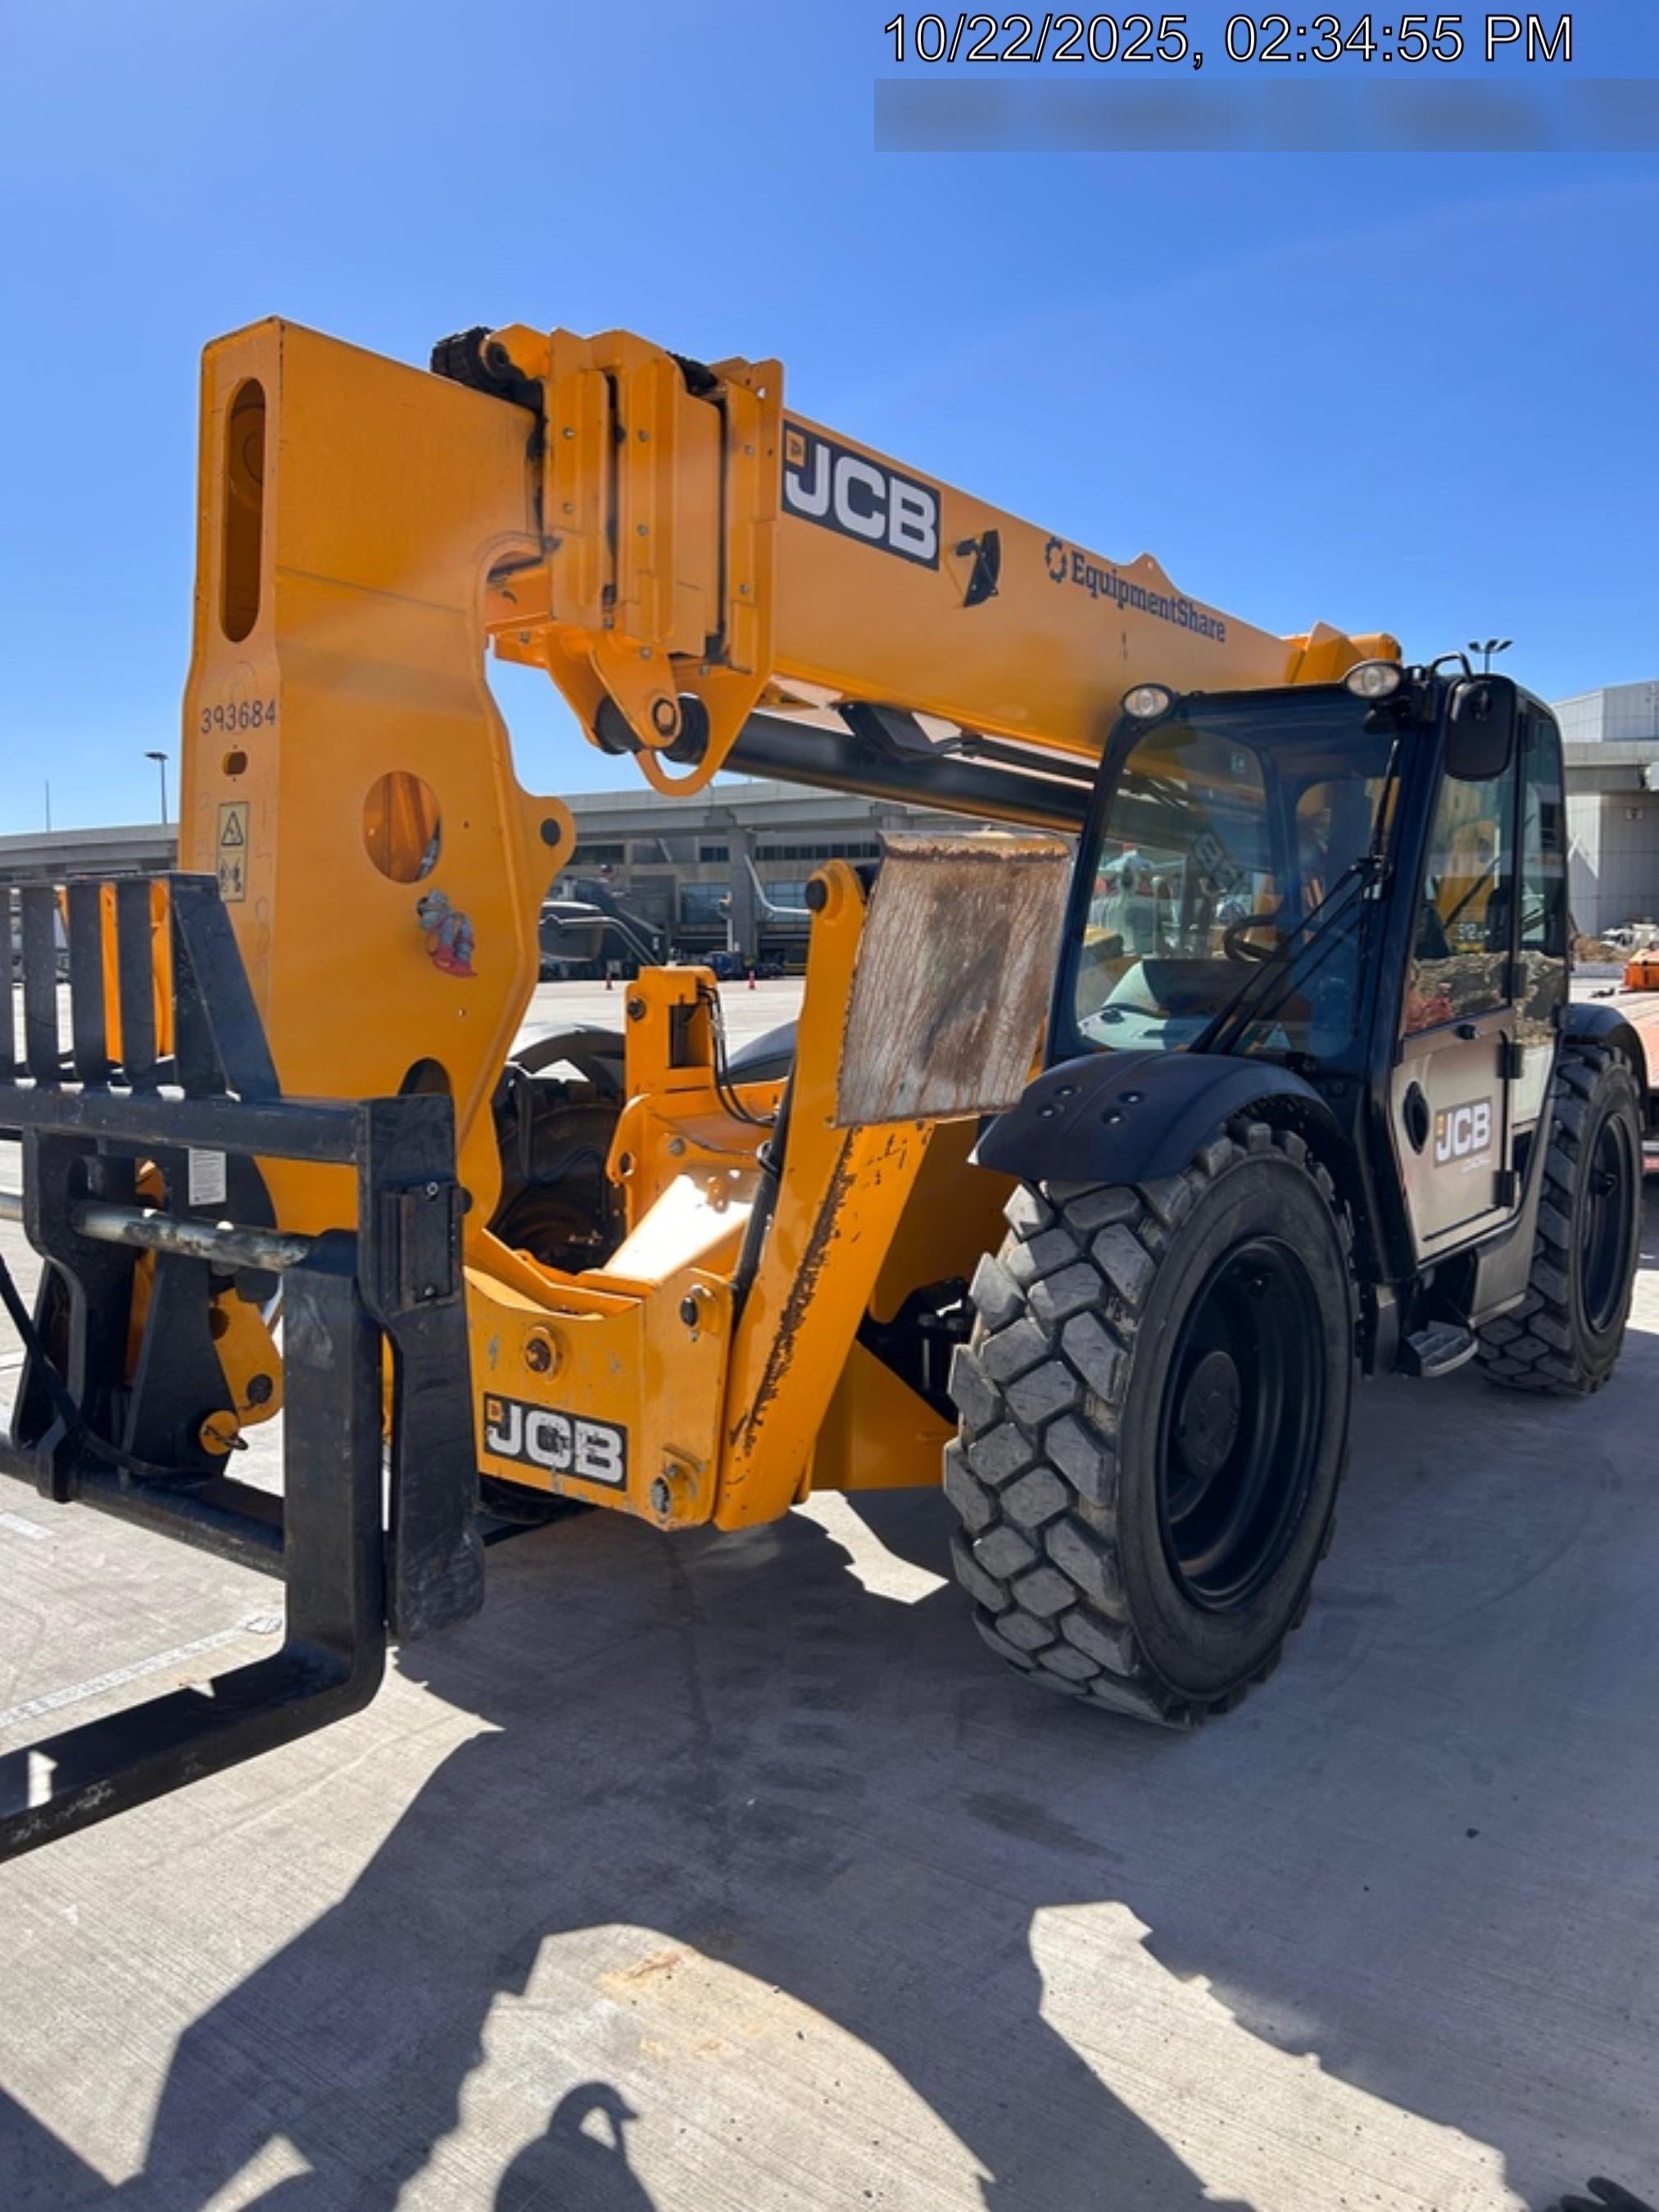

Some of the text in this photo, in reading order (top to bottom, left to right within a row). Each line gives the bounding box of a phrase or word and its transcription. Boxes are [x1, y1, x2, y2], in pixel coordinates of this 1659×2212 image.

[785, 443, 936, 560] JCB
[1071, 550, 1226, 642] EquipmentShare
[201, 699, 276, 734] 393684
[1435, 1103, 1490, 1161] JCB
[487, 1403, 623, 1483] JCB
